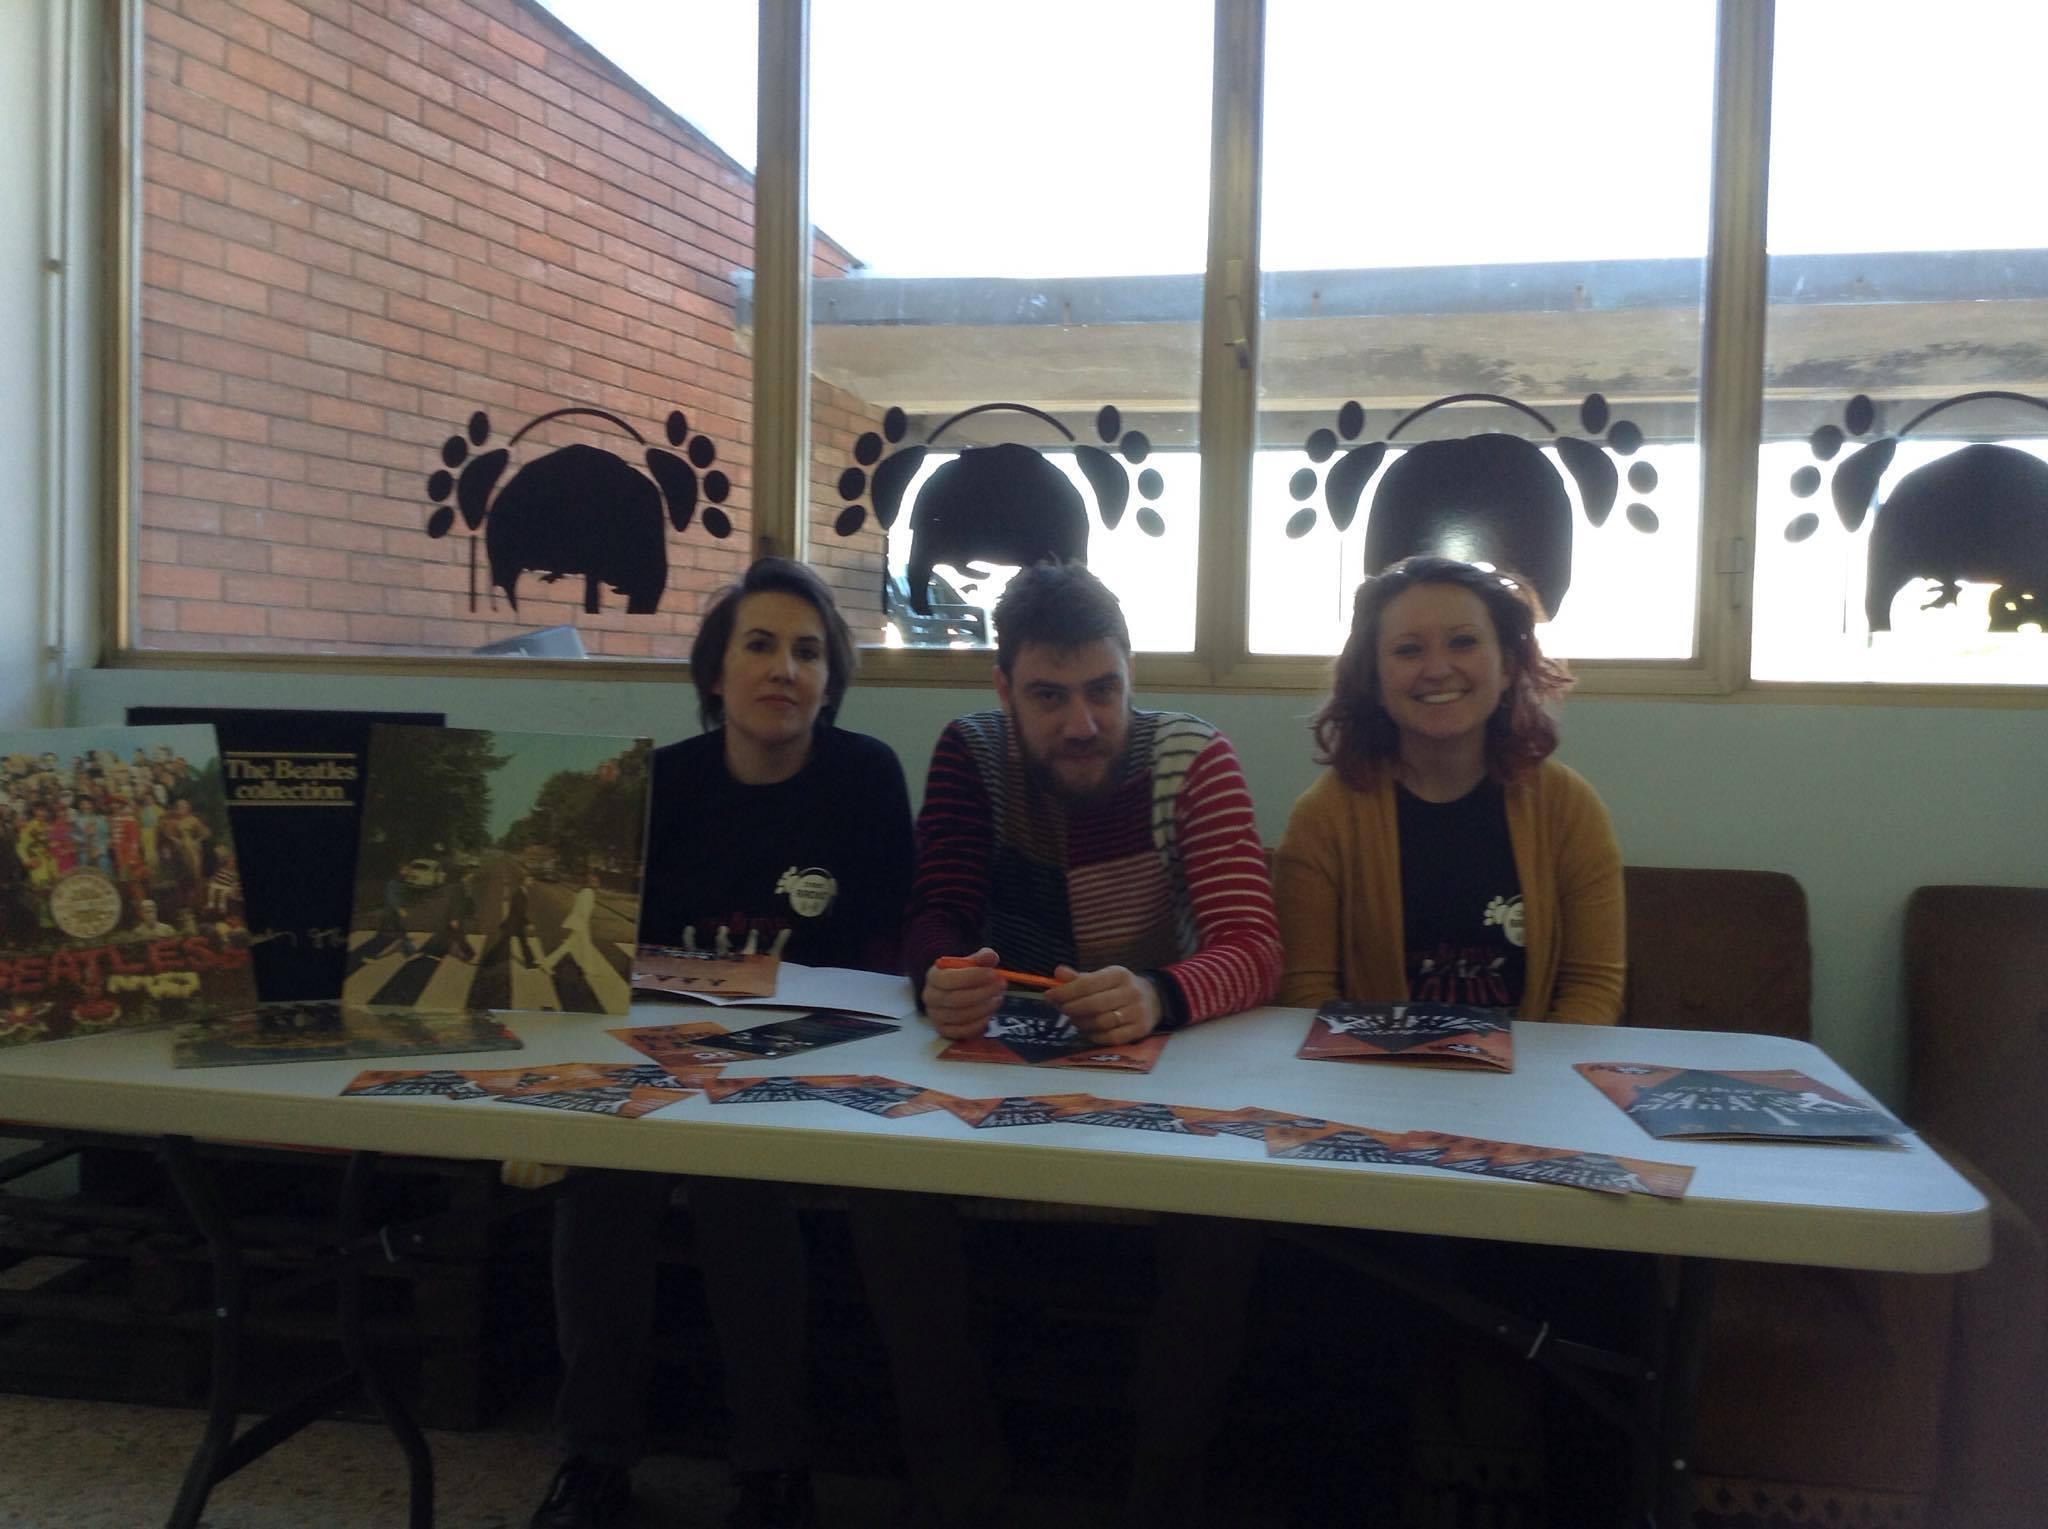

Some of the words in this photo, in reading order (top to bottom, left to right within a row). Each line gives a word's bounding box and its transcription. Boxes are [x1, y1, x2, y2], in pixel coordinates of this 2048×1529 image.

[224, 759, 271, 779] The
[275, 759, 358, 779] Beatles
[236, 779, 345, 799] collection
